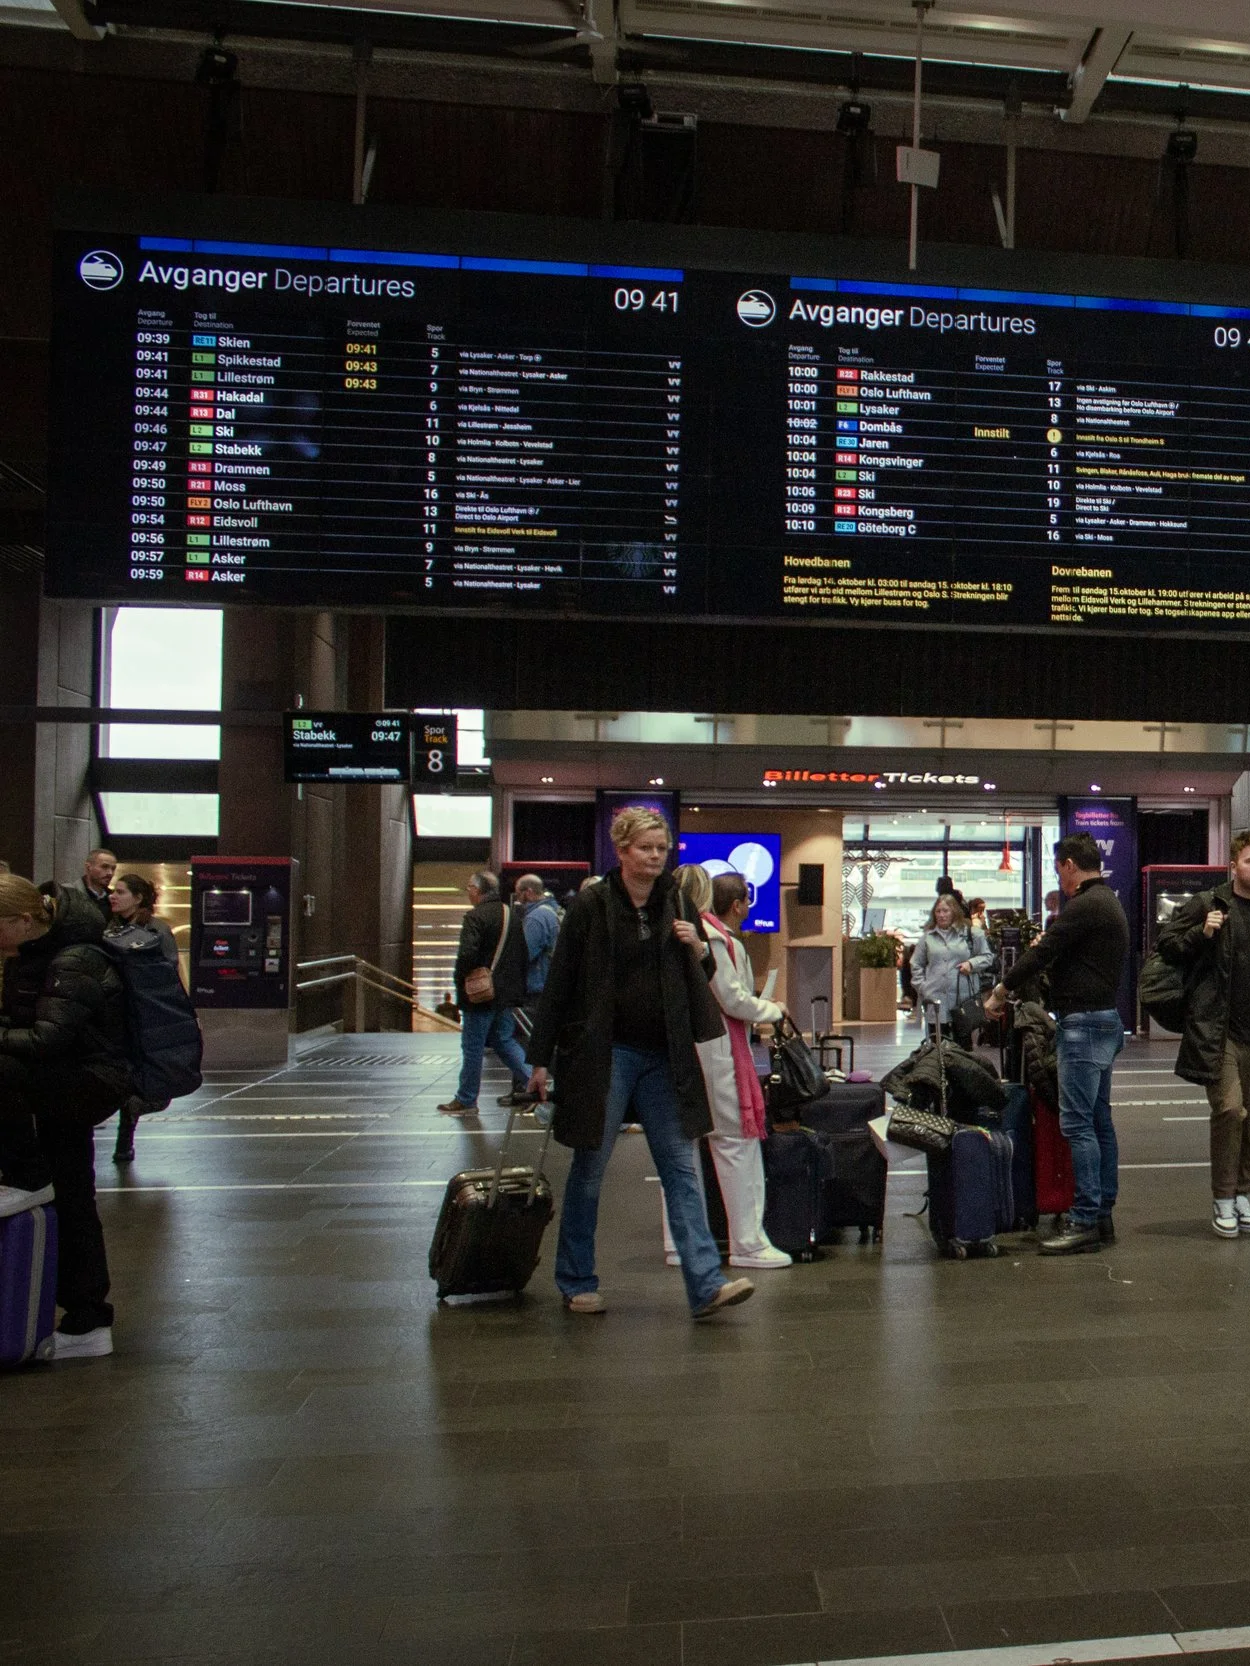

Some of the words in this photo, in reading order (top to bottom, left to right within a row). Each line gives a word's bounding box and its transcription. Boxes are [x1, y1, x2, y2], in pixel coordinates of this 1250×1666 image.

[139, 261, 267, 290] Avganger
[274, 268, 415, 298] Departures
[615, 289, 644, 310] 09
[651, 291, 678, 312] 41
[138, 318, 173, 327] Departure
[193, 320, 233, 329] Destination
[789, 299, 903, 329] Avganger
[910, 307, 1036, 334] Departures
[1215, 327, 1240, 347] 09
[137, 332, 169, 344] 09:39
[218, 337, 250, 349] Skien
[346, 343, 377, 355] 09:41
[137, 350, 168, 362] 09:41
[218, 354, 281, 368] Spikkestad
[346, 361, 377, 372] 09:43
[136, 368, 168, 380] 09:41
[217, 372, 274, 384] Lillestrøm
[345, 378, 377, 390] 09:43
[788, 367, 818, 378] 10:00
[860, 371, 914, 383] Rakkestad
[1049, 382, 1061, 391] 17
[194, 391, 209, 399] R31
[217, 392, 264, 403] Hakadal
[788, 384, 817, 394] 10:00
[860, 387, 883, 397] Oslo
[886, 389, 931, 400] Lufthavn
[135, 405, 168, 416] 09:44
[217, 409, 234, 419] Dal
[788, 400, 816, 411] 10:01
[860, 404, 899, 416] Lysaker
[134, 423, 167, 434] 09:46
[216, 426, 234, 437] Ski
[860, 421, 902, 433] Dombås
[974, 427, 1009, 439] Innstilt
[134, 441, 167, 452] 09:47
[215, 444, 261, 456] Stabekk
[787, 435, 816, 446] 10:04
[859, 438, 888, 449] Jaren
[787, 452, 816, 462] 10:04
[859, 455, 923, 468] Kongsvinger
[133, 460, 166, 472] 09:49
[215, 464, 270, 475] Drammen
[787, 468, 815, 479] 10:04
[859, 471, 875, 482] Ski
[133, 478, 165, 490] 09:50
[214, 481, 246, 492] Moss
[424, 489, 438, 499] 16
[786, 486, 815, 497] 10:06
[214, 500, 240, 510] Oslo
[243, 500, 292, 512] Lufthavn
[786, 503, 814, 513] 10:09
[858, 506, 913, 519] Kongsberg
[132, 514, 164, 525] 09:54
[214, 517, 258, 528] Eidsvoll
[786, 520, 814, 530] 10:10
[858, 523, 905, 535] Göteborg
[1047, 531, 1059, 540] 16
[132, 533, 164, 544] 09:56
[213, 536, 270, 548] Lillestrøm
[131, 551, 164, 562] 09:57
[212, 554, 245, 565] Asker
[785, 556, 850, 568] Hovedbanen
[131, 569, 163, 580] 09:59
[212, 572, 245, 583] Asker
[1052, 566, 1112, 577] Dovrebanen
[878, 579, 898, 587] 03:00
[909, 581, 936, 590] søndag
[992, 583, 1012, 591] 18:10
[293, 731, 336, 740] Stabekk
[371, 731, 401, 741] 09:47
[425, 726, 445, 735] Spor
[425, 735, 448, 743] Track
[428, 750, 443, 772] 8
[764, 771, 879, 782] Billetter
[883, 772, 979, 784] Tickets
